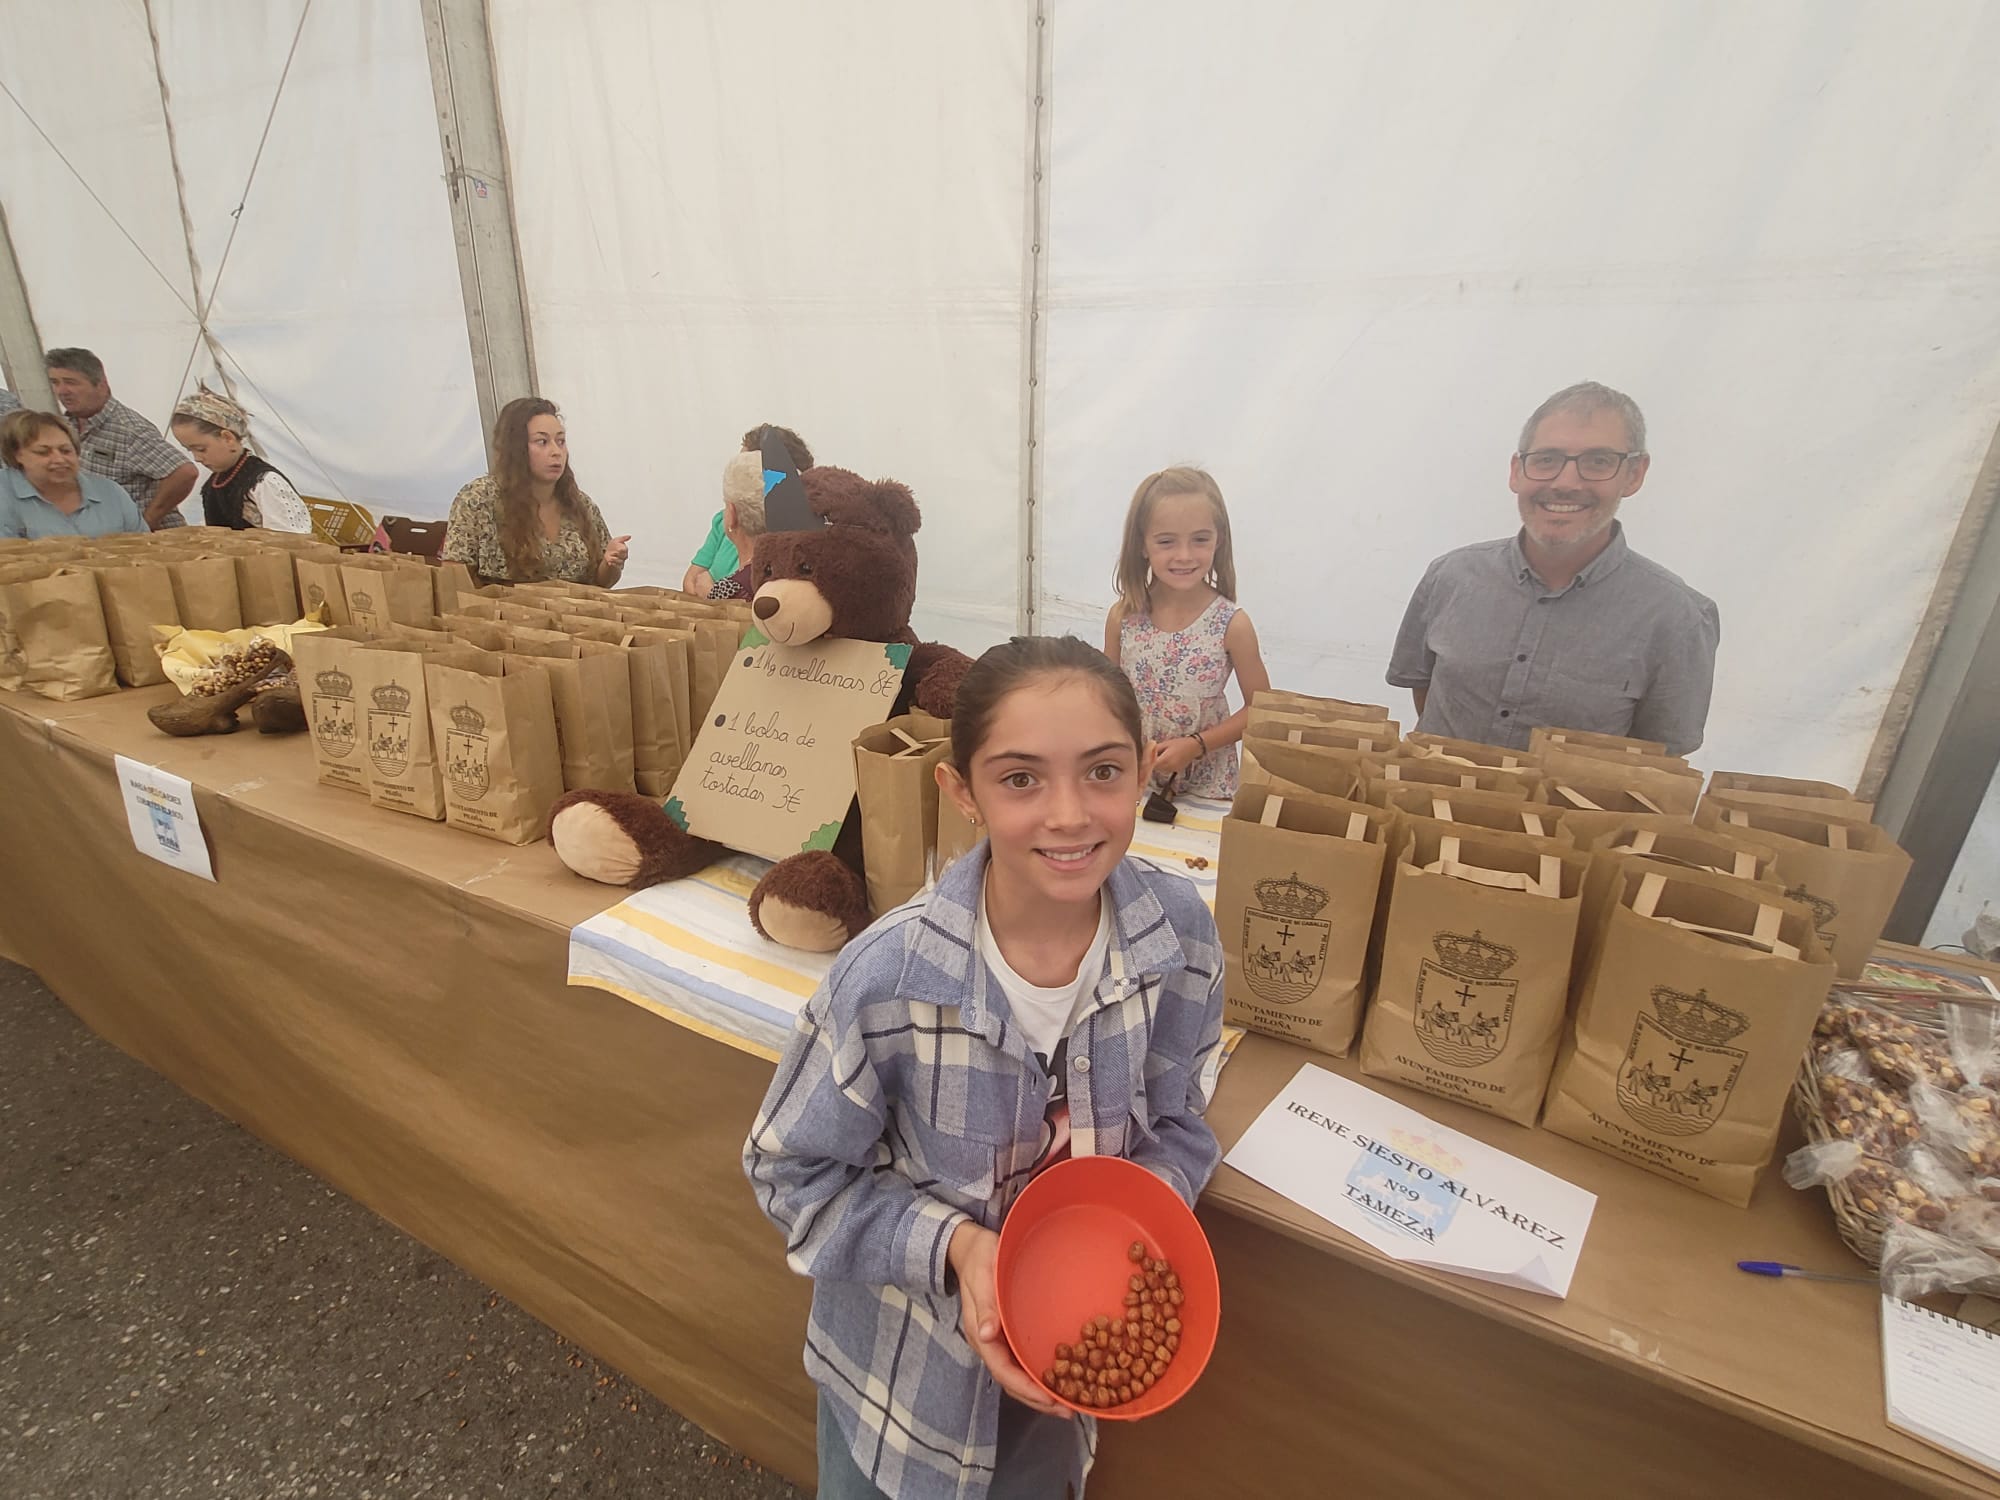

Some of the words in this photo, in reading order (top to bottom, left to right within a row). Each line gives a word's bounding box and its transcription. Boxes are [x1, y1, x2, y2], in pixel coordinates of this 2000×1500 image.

[779, 658, 865, 691] avellanas
[870, 669, 898, 698] 8€
[728, 711, 741, 731] 1
[744, 711, 789, 743] bolsa
[795, 723, 816, 748] de
[709, 741, 787, 779] avellanas
[699, 766, 765, 803] tostadas
[771, 784, 805, 813] 3€
[1228, 997, 1306, 1024] AYUNTAMIENTO
[1308, 1018, 1323, 1027] DE
[1254, 1015, 1292, 1031] PILOÑA
[1395, 1054, 1487, 1089] AYUNTAMIENTO
[1489, 1085, 1506, 1094] DE
[1588, 1112, 1696, 1160] AYUNTAMIENTO
[1699, 1157, 1719, 1167] DE
[1286, 1101, 1351, 1138] IRENE
[1353, 1134, 1434, 1181] SIESTO
[1438, 1178, 1568, 1250] ALVAREZ
[1345, 1183, 1436, 1242] TAMEZA
